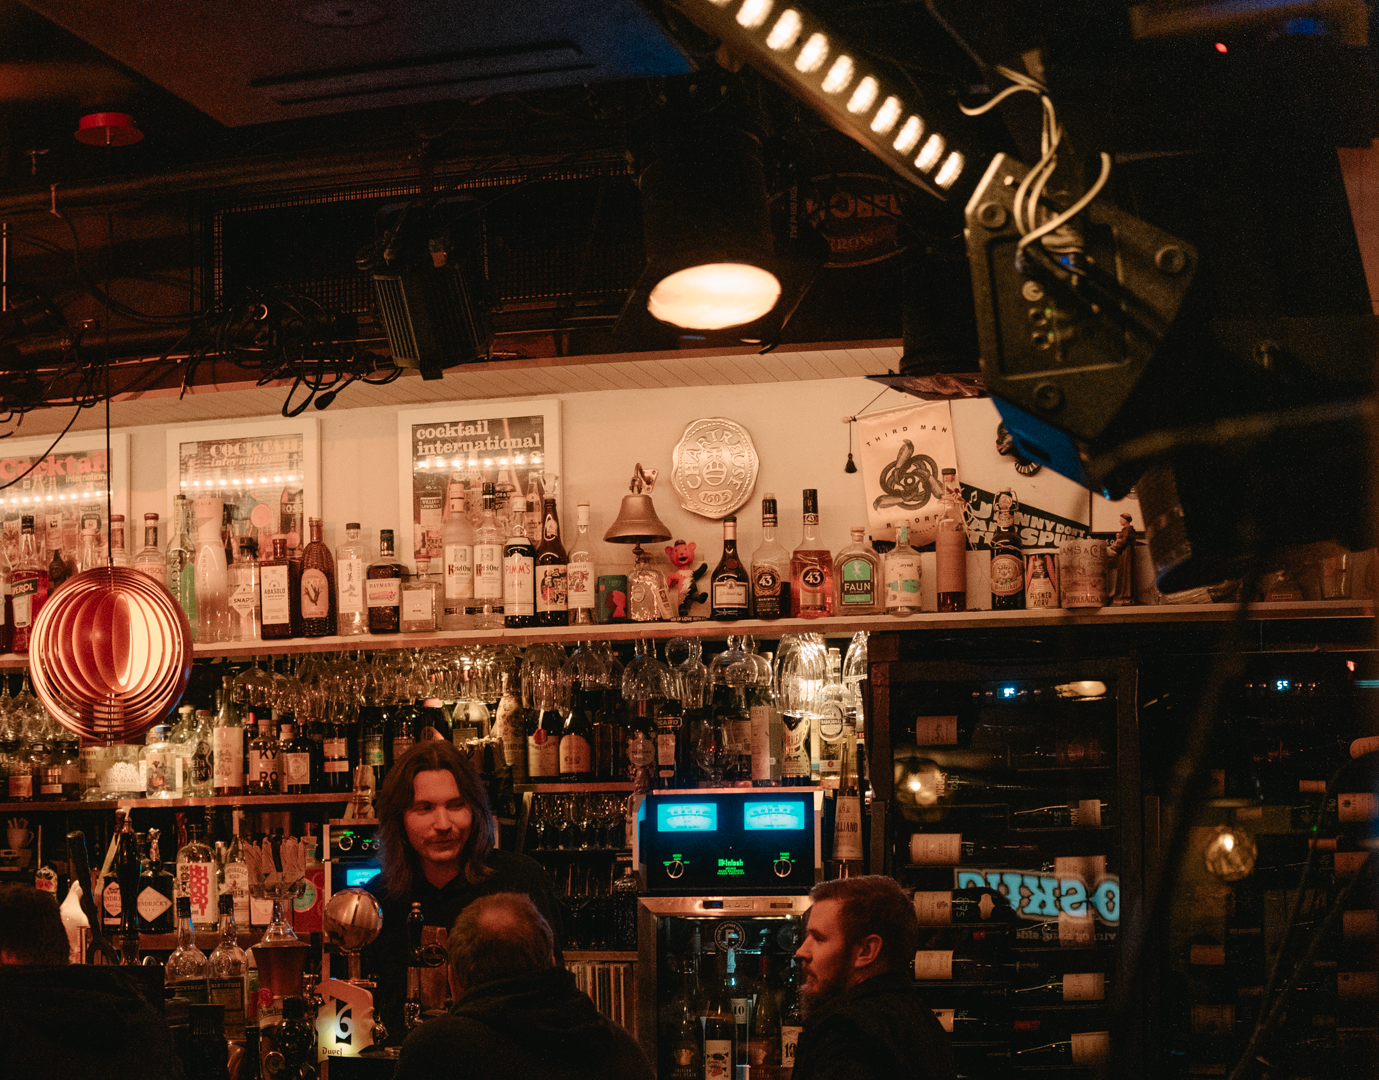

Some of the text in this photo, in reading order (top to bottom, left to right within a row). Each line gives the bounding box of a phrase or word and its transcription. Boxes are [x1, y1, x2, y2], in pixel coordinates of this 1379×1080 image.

[416, 420, 490, 440] cocktail
[866, 424, 948, 447] THIRD MAN
[416, 432, 542, 456] international
[685, 428, 746, 491] CHARTREUSE
[969, 500, 1057, 528] JNNY
[505, 564, 531, 576] PIMM'S
[758, 576, 773, 587] 43
[804, 572, 821, 584] 43
[264, 587, 286, 595] ABASOLO
[844, 582, 871, 592] FAUN
[1030, 591, 1052, 600] PILSNER
[733, 1005, 745, 1014] 10
